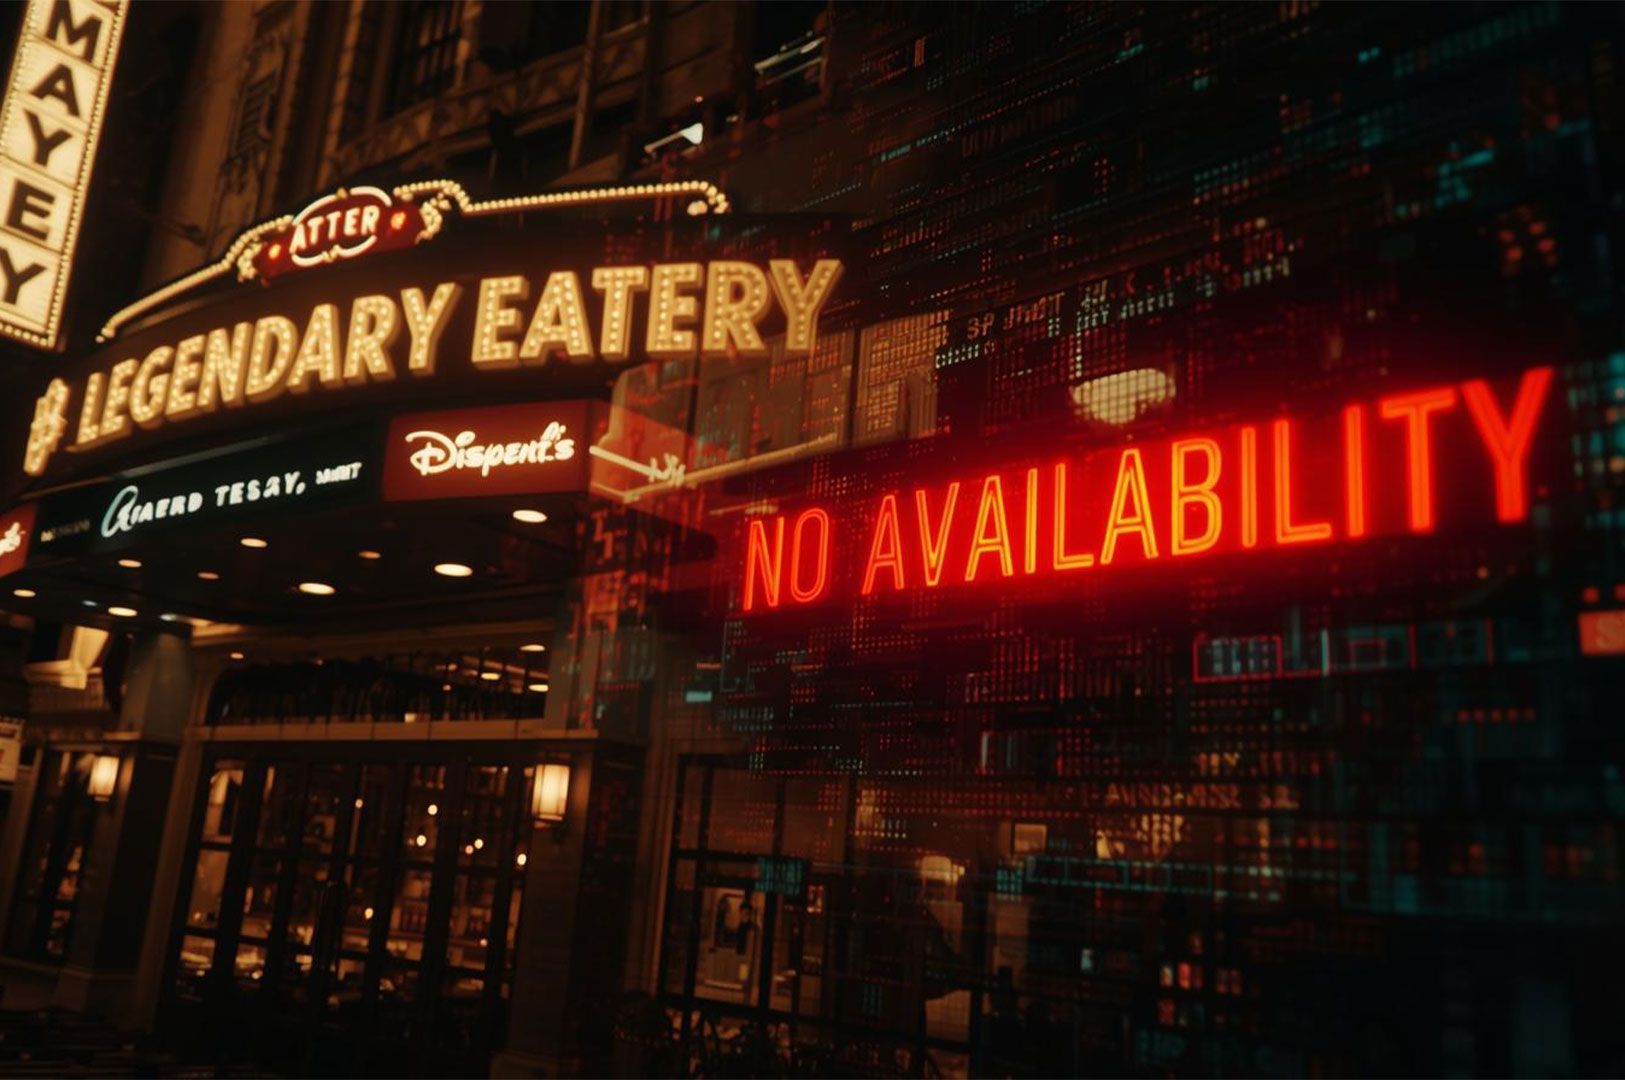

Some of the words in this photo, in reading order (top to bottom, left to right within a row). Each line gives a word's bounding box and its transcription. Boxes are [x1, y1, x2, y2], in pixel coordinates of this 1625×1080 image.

[290, 205, 381, 253] ATTER
[73, 281, 461, 449] LEGENDARY
[471, 258, 843, 370] EATERY
[743, 506, 831, 612] NO
[860, 366, 1555, 594] AVAILABILITY
